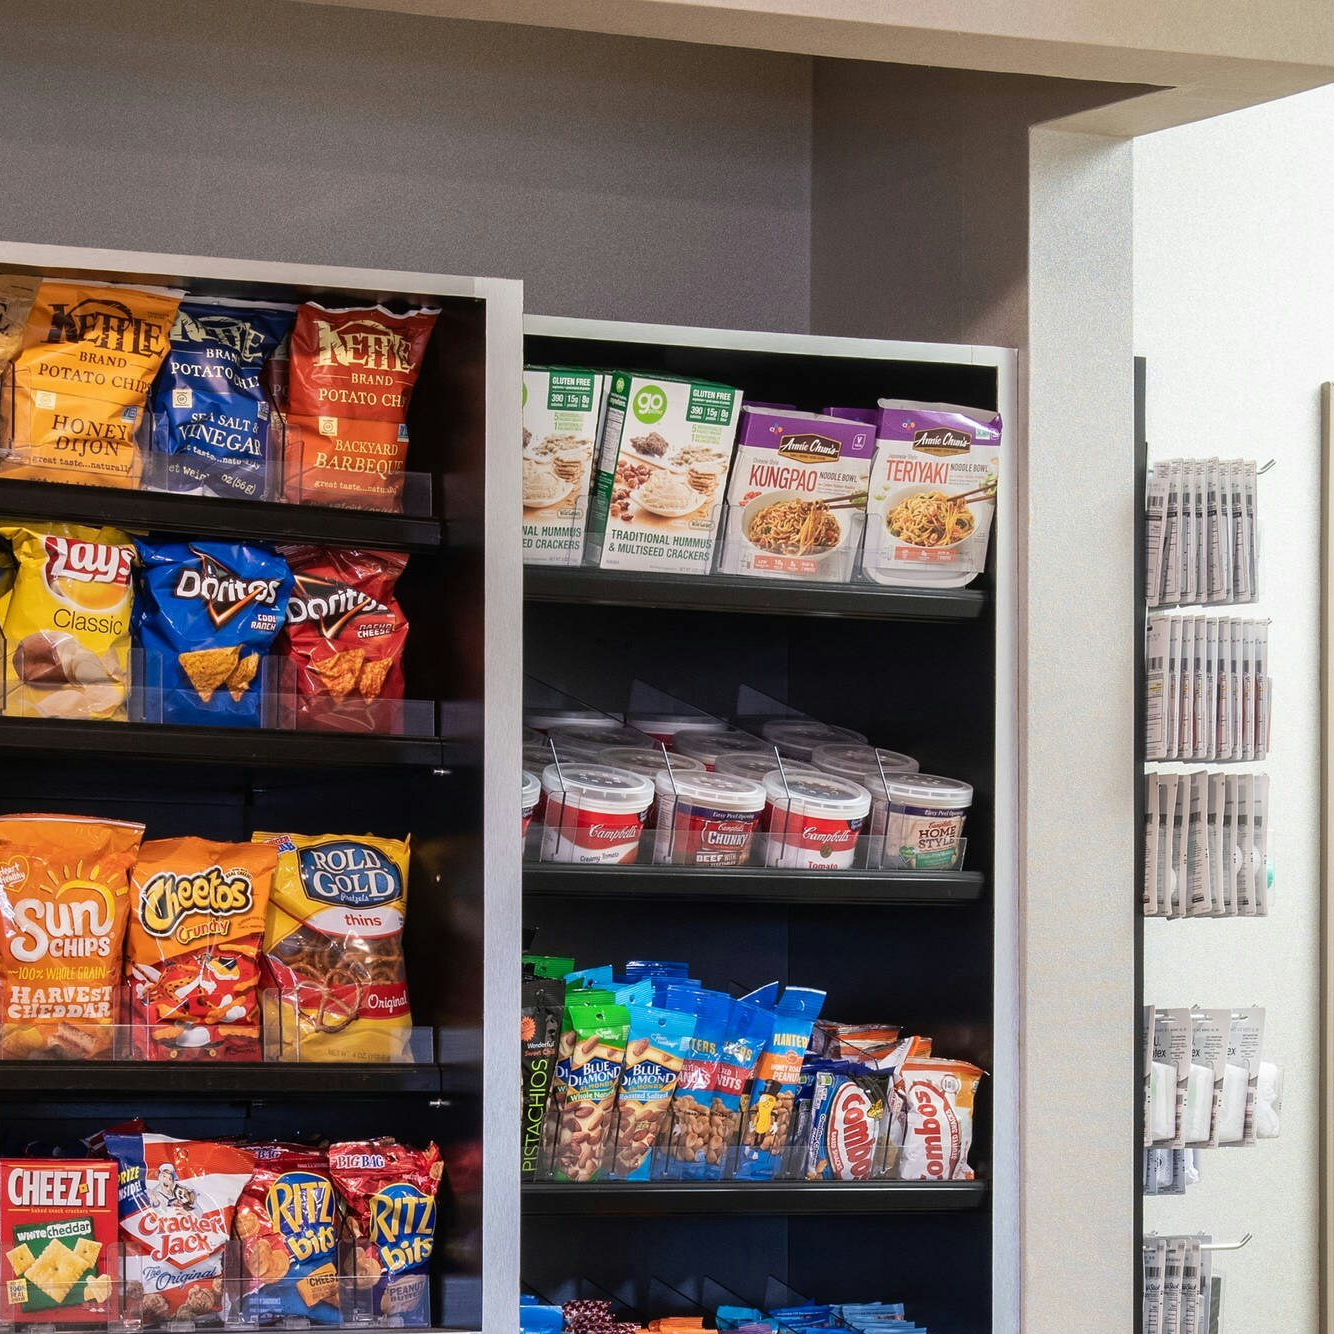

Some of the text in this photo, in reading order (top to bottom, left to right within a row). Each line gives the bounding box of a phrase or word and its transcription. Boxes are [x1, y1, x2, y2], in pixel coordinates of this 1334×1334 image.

[41, 298, 165, 358] KETTLE
[313, 319, 415, 373] KETTLE
[79, 352, 127, 368] BRAND
[39, 363, 105, 385] POTATO
[351, 374, 393, 386] BRAND
[552, 377, 591, 386] GLUTEN FREE
[319, 389, 405, 407] POTATO CH
[638, 394, 663, 410] go
[693, 389, 731, 400] GLUTEN FREE
[52, 415, 127, 440] HONEY
[54, 436, 120, 457] DIJON
[179, 425, 262, 456] VINEGAR
[336, 440, 398, 456] BACKYARD
[780, 438, 809, 450] Annie
[915, 432, 942, 446] Annie
[316, 452, 403, 480] BARBEQUE
[887, 460, 948, 484] TERIYAKI
[950, 464, 989, 472] NOODLE BOWL
[819, 472, 858, 483] NOODLE BOWL
[541, 526, 581, 537] HUMMUS
[612, 530, 712, 548] TRADITIONAL HUMMUS
[536, 539, 580, 549] CRACKERS
[609, 543, 710, 561] & MULTISEED CRACKERS
[177, 570, 280, 603] Doritos
[54, 609, 122, 635] Classic
[707, 833, 748, 846] CHUNKY
[919, 826, 956, 838] HOME
[919, 838, 955, 848] STYLE
[311, 849, 381, 873] ROLD
[314, 869, 395, 897] GOLD
[142, 870, 252, 932] Cheetos
[345, 914, 382, 926] thins
[10, 898, 115, 962] Sun
[177, 919, 230, 944] Crunchy
[50, 937, 110, 957] CHIPS
[19, 967, 105, 980] 100% WHOLE GRAIN
[10, 986, 112, 1003] HARVEST
[8, 1003, 110, 1019] CHEDDAR
[569, 1067, 621, 1086] DIAMOND
[583, 1062, 609, 1075] BLUE
[633, 1065, 661, 1076] BLUE
[622, 1073, 676, 1085] DIAMOND
[522, 1059, 548, 1171] PISTACHIOS
[336, 1155, 384, 1168] BIG BAG
[270, 1182, 334, 1233] RITZ
[138, 1212, 227, 1235] Cracker
[369, 1196, 435, 1242] RITZ
[152, 1234, 211, 1261] Jack
[288, 1226, 335, 1260] bits
[381, 1237, 434, 1271] bits
[156, 1267, 216, 1290] Original
[389, 1283, 424, 1296] PEANUT
